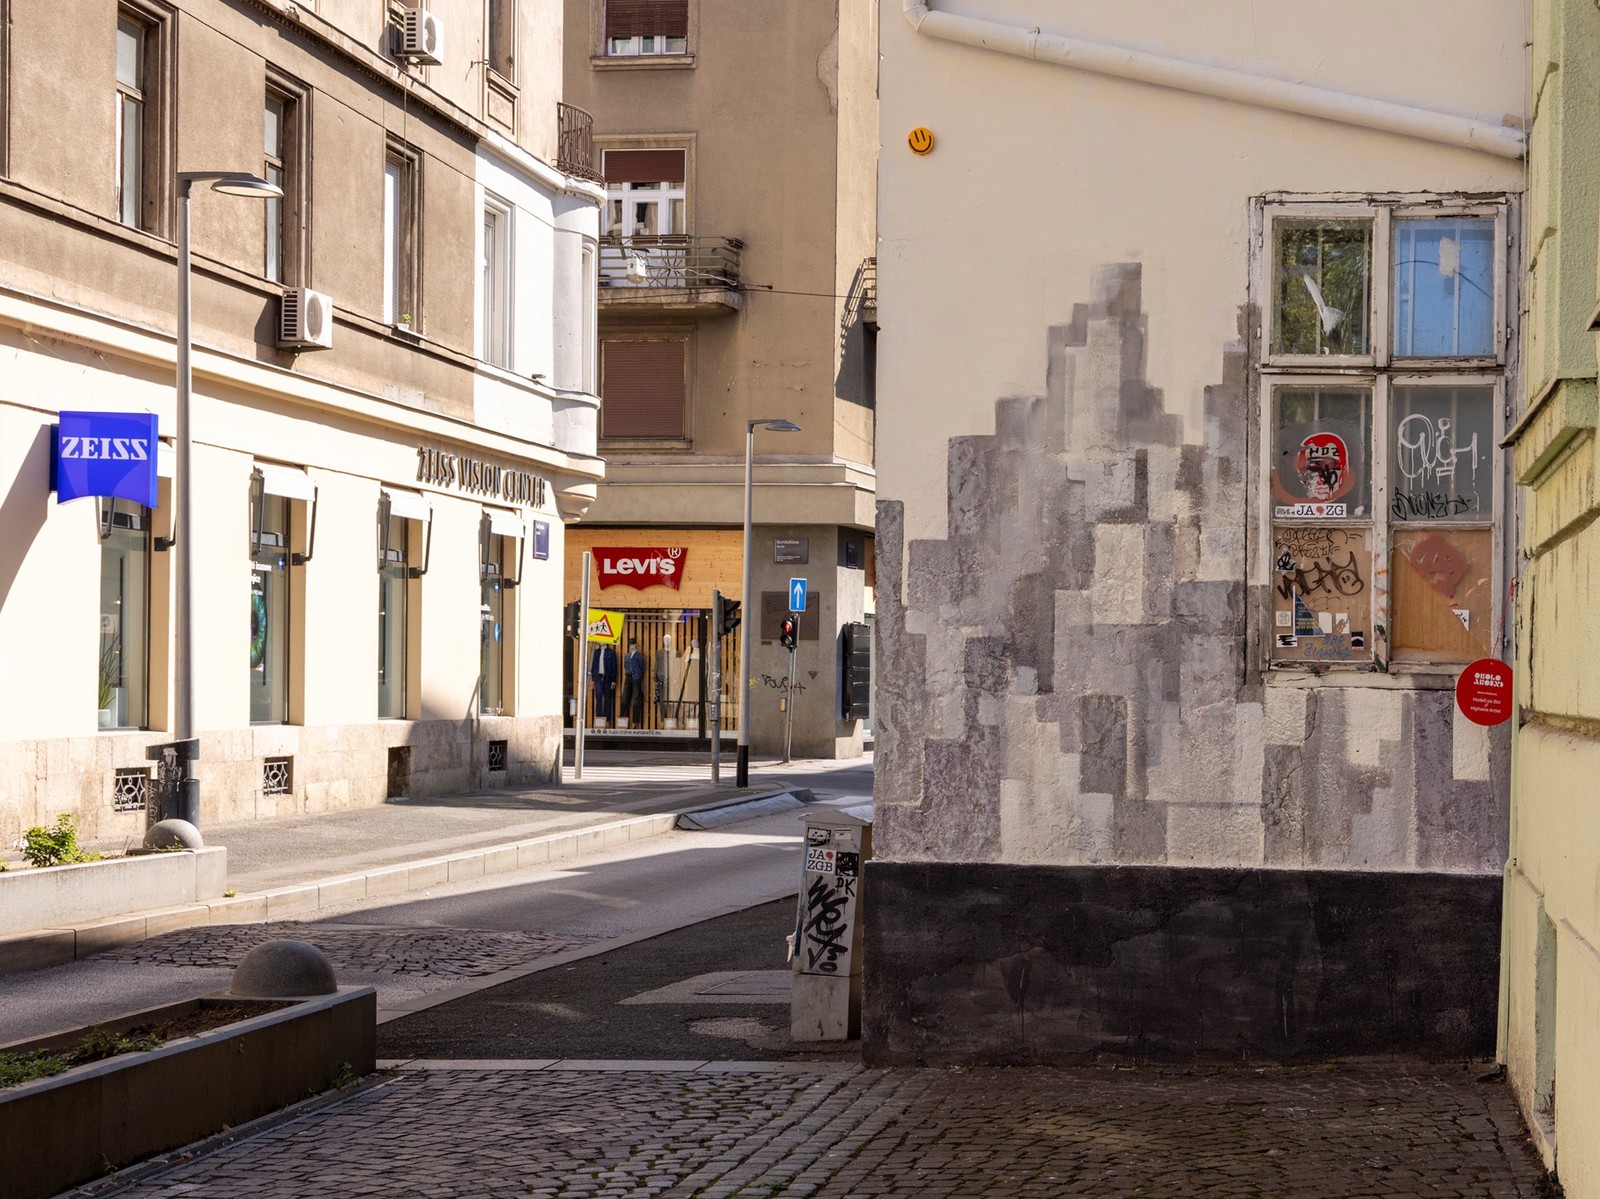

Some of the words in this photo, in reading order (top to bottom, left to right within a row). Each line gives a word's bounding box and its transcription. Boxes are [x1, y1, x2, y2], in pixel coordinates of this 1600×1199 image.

[61, 436, 148, 461] ZEISS
[457, 456, 501, 497] VISION
[502, 469, 546, 507] CENTER
[1296, 504, 1316, 516] JA
[1325, 504, 1345, 516] ZG
[1474, 672, 1502, 681] OKOLO
[808, 849, 826, 860] JA
[807, 860, 833, 872] ZGB
